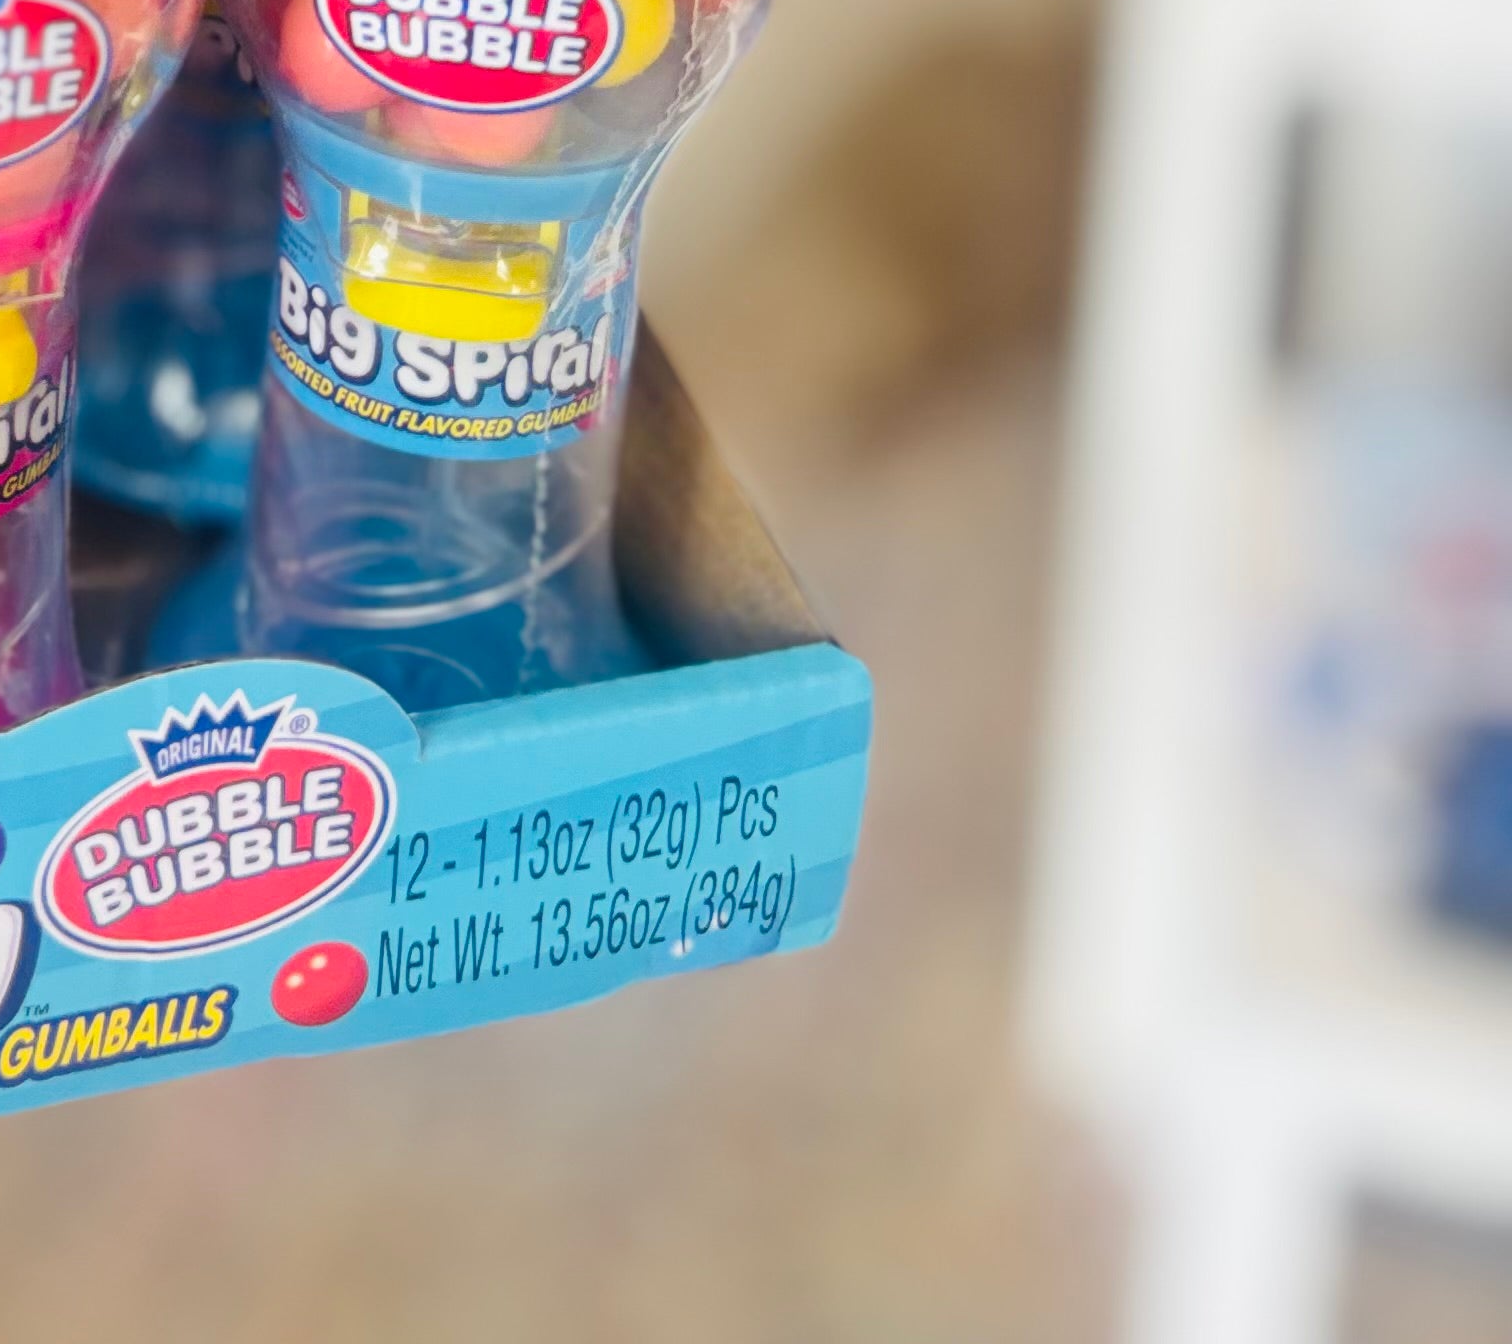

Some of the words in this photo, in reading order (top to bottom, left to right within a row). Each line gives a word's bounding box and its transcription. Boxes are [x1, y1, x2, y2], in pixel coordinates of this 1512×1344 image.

[347, 9, 589, 77] BUBBLE
[278, 255, 380, 384] Big
[334, 385, 395, 424] FRUIT
[395, 408, 514, 439] FLAVORED
[156, 725, 257, 772] ORIGINAL
[72, 765, 345, 882] DUBBLE
[83, 811, 356, 928] BUBBLE
[387, 831, 430, 904] 12
[473, 808, 594, 890] 1.13oz
[606, 780, 702, 884] (32g)
[716, 774, 778, 845] Pcs
[376, 924, 440, 998] Net
[453, 910, 510, 985] Wt.
[531, 885, 671, 971] 13.56oz
[680, 853, 796, 954] (384g)
